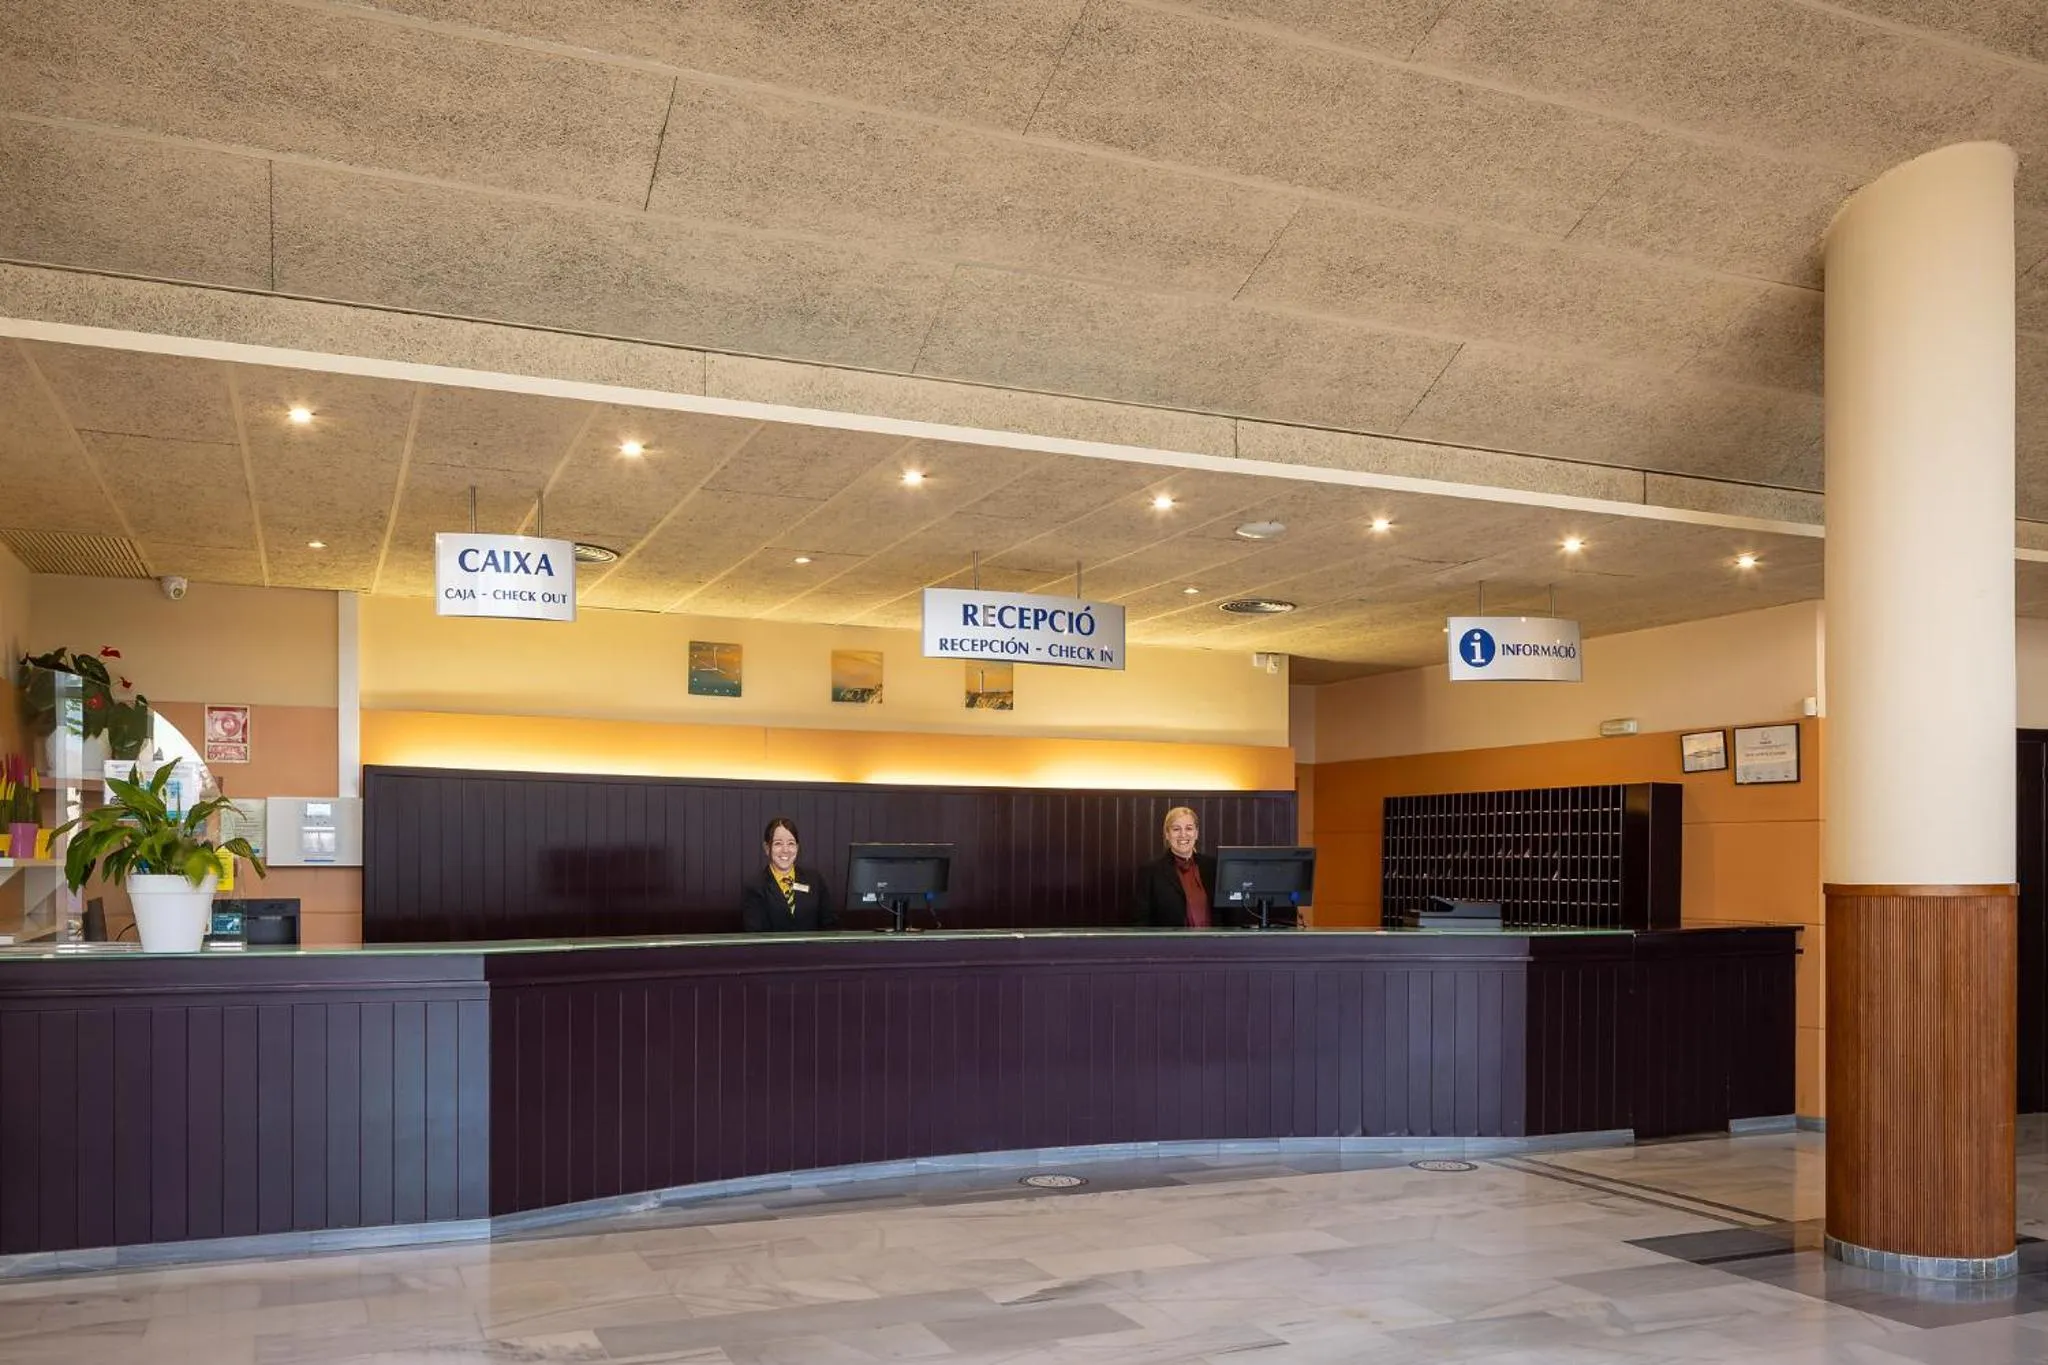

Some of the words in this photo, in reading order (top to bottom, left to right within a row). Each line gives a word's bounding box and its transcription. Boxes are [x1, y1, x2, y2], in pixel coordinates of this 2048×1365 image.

[458, 548, 554, 577] CAIXA
[444, 587, 476, 601] CAJA
[493, 589, 536, 602] CHECK
[541, 592, 568, 604] OUT
[962, 603, 1095, 637] RECEPCIÓ
[939, 637, 1029, 655] RECEPCIÓN
[1048, 643, 1095, 661] CHECK
[1100, 649, 1114, 662] IN
[1501, 643, 1577, 659] INFORMACIÓ
